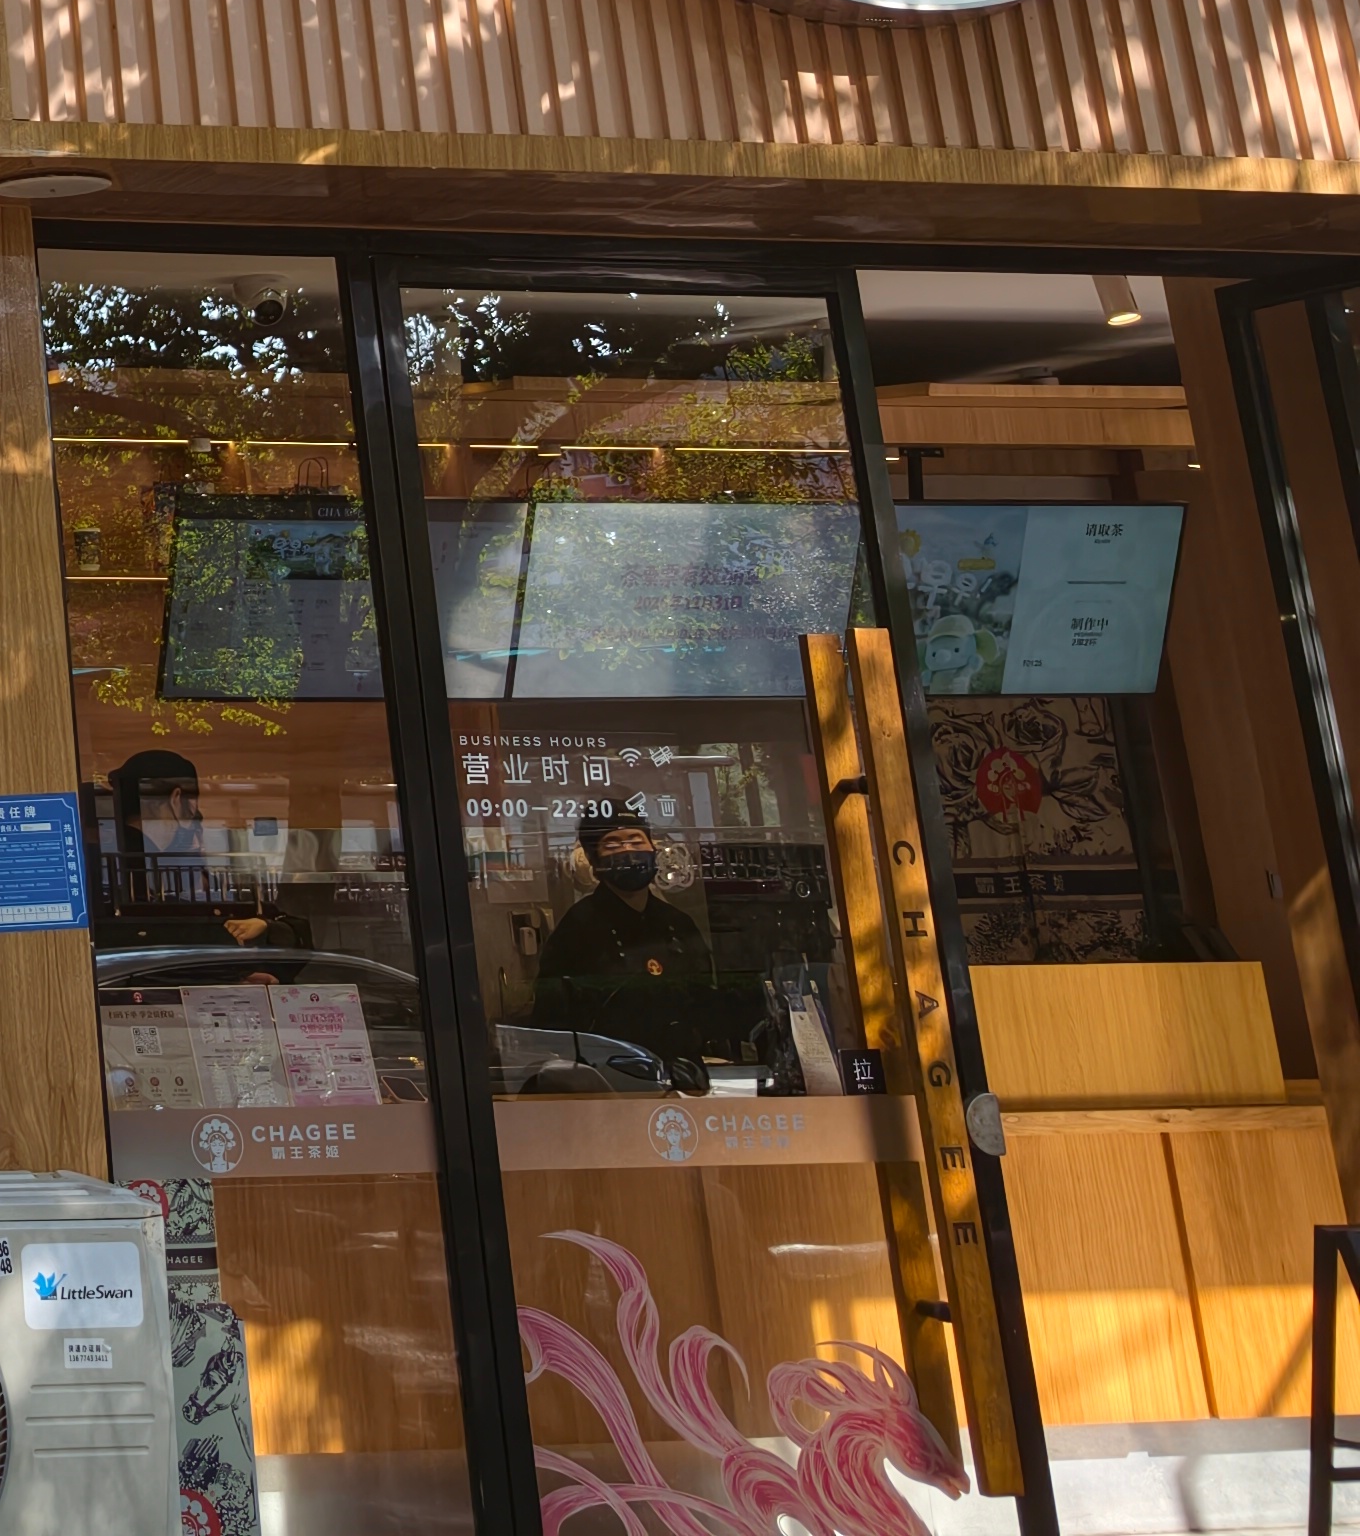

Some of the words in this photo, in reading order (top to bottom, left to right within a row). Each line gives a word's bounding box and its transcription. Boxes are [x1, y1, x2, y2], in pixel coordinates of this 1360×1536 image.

[1085, 523, 1124, 537] 请取茶
[459, 735, 542, 747] BUSINESS
[549, 736, 607, 748] HOURS
[461, 753, 611, 786] 营业时间
[63, 823, 79, 897] 共建文明城市
[892, 839, 979, 1247] CHAGEE
[852, 1058, 874, 1081] 拉
[705, 1114, 806, 1132] CHAGEE
[251, 1123, 357, 1142] CHAGEE
[271, 1145, 340, 1159] 霸王茶姬
[166, 1255, 204, 1264] HAGEE
[60, 1285, 133, 1300] LittleSwan
